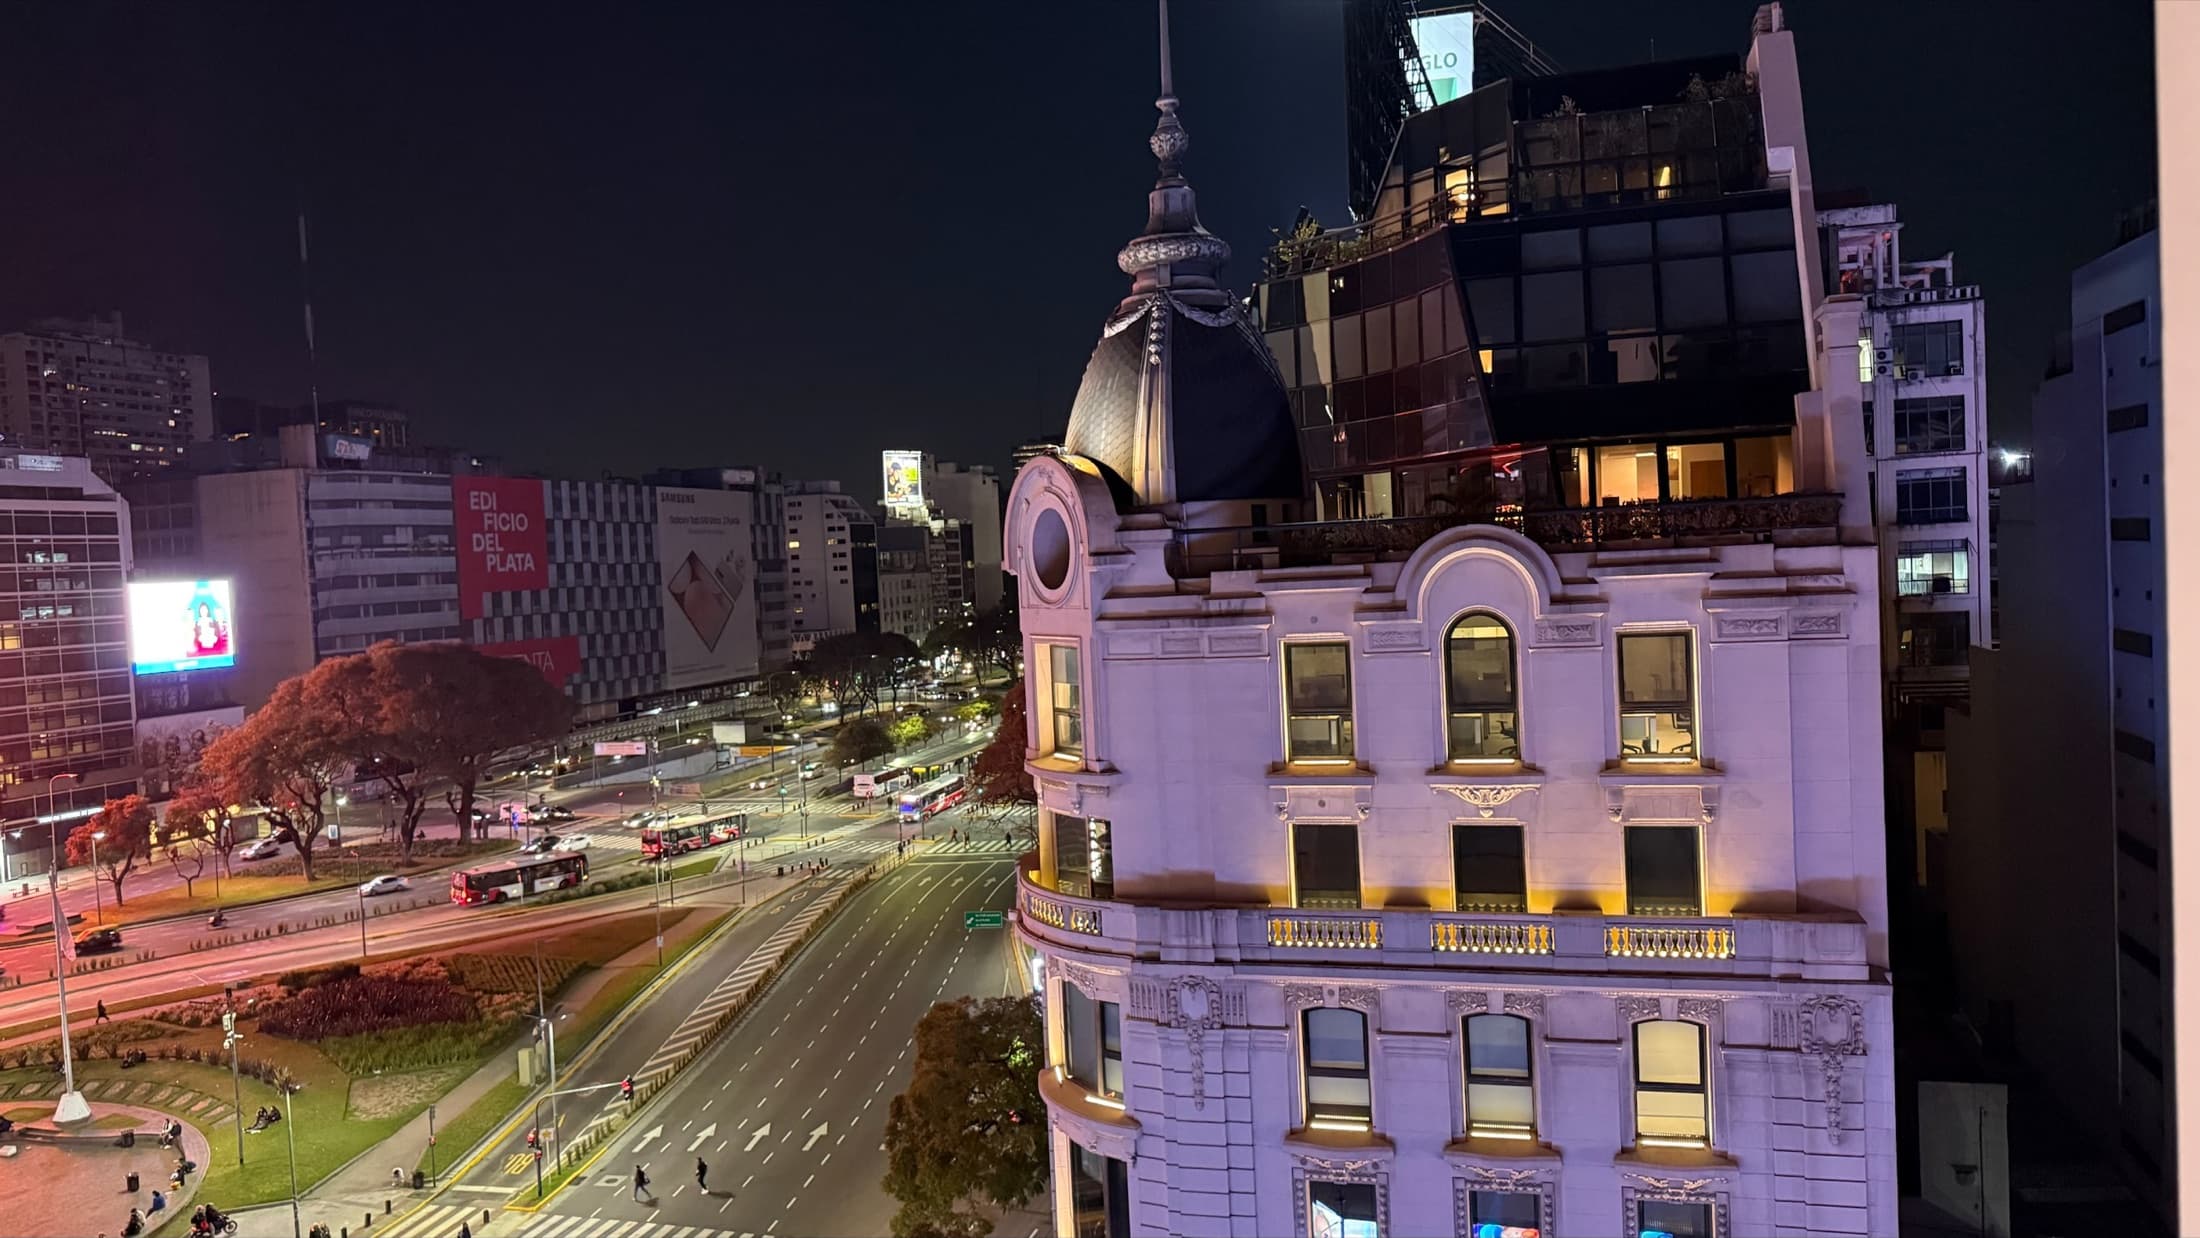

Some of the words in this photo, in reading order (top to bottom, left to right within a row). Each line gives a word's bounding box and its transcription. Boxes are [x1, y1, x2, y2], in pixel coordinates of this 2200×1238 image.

[469, 491, 497, 511] EDI
[661, 492, 696, 504] SAMSUNG
[483, 512, 529, 532] FICIO
[472, 533, 504, 552] DEL
[486, 553, 535, 573] PLATA
